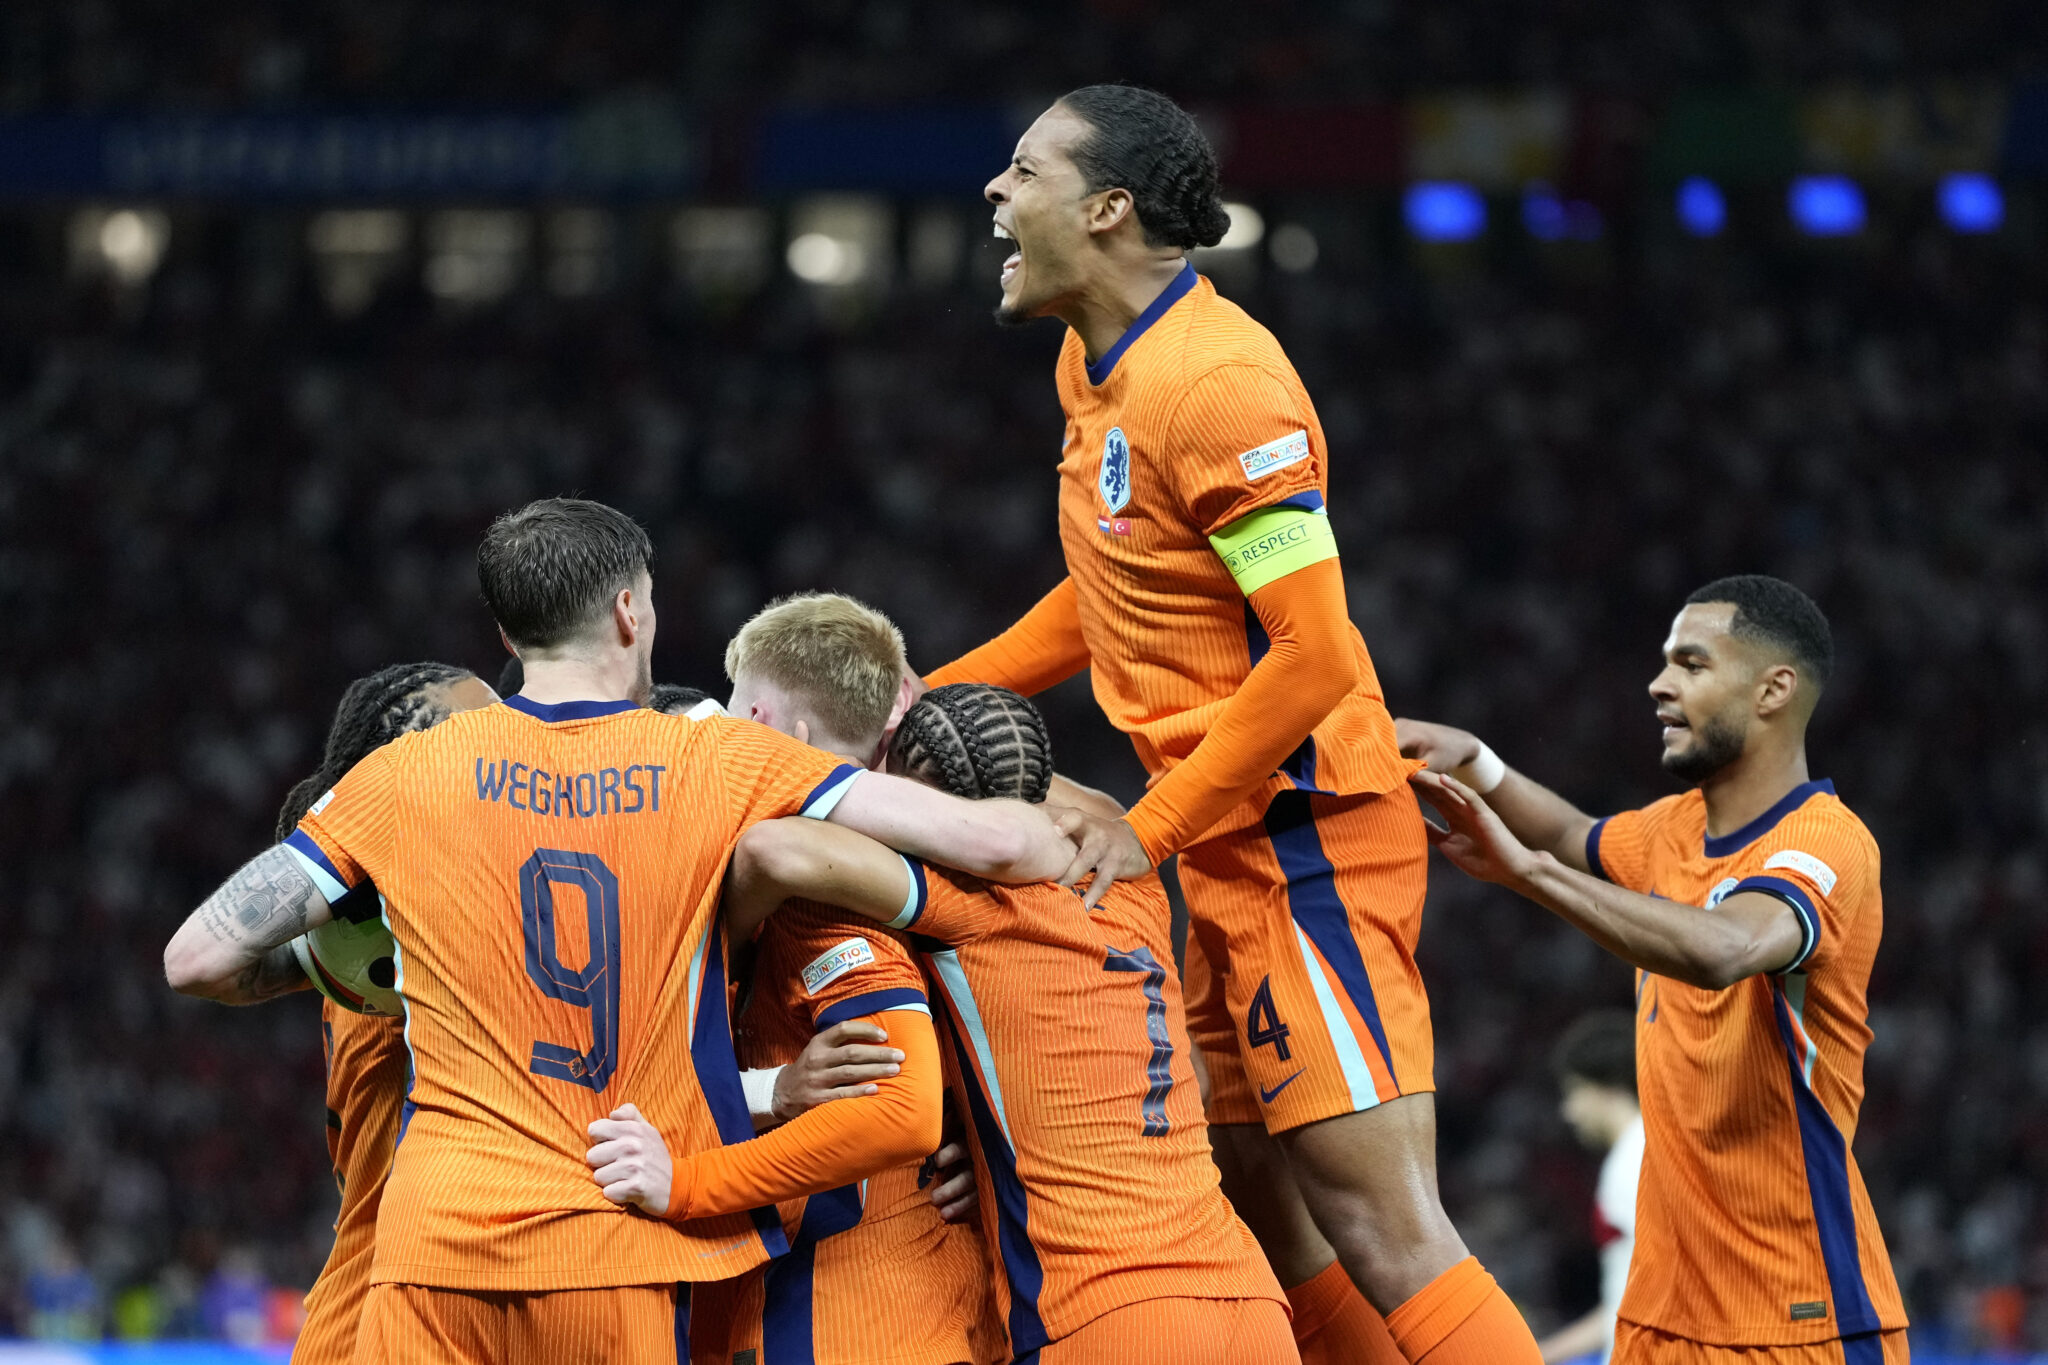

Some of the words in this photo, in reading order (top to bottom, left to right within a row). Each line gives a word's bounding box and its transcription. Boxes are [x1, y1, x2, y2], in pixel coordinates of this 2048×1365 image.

[1241, 524, 1307, 563] RESPECT
[475, 757, 666, 819] WEGHORST
[519, 847, 621, 1094] 9
[1102, 944, 1174, 1138] 7
[1248, 973, 1292, 1063] 4
